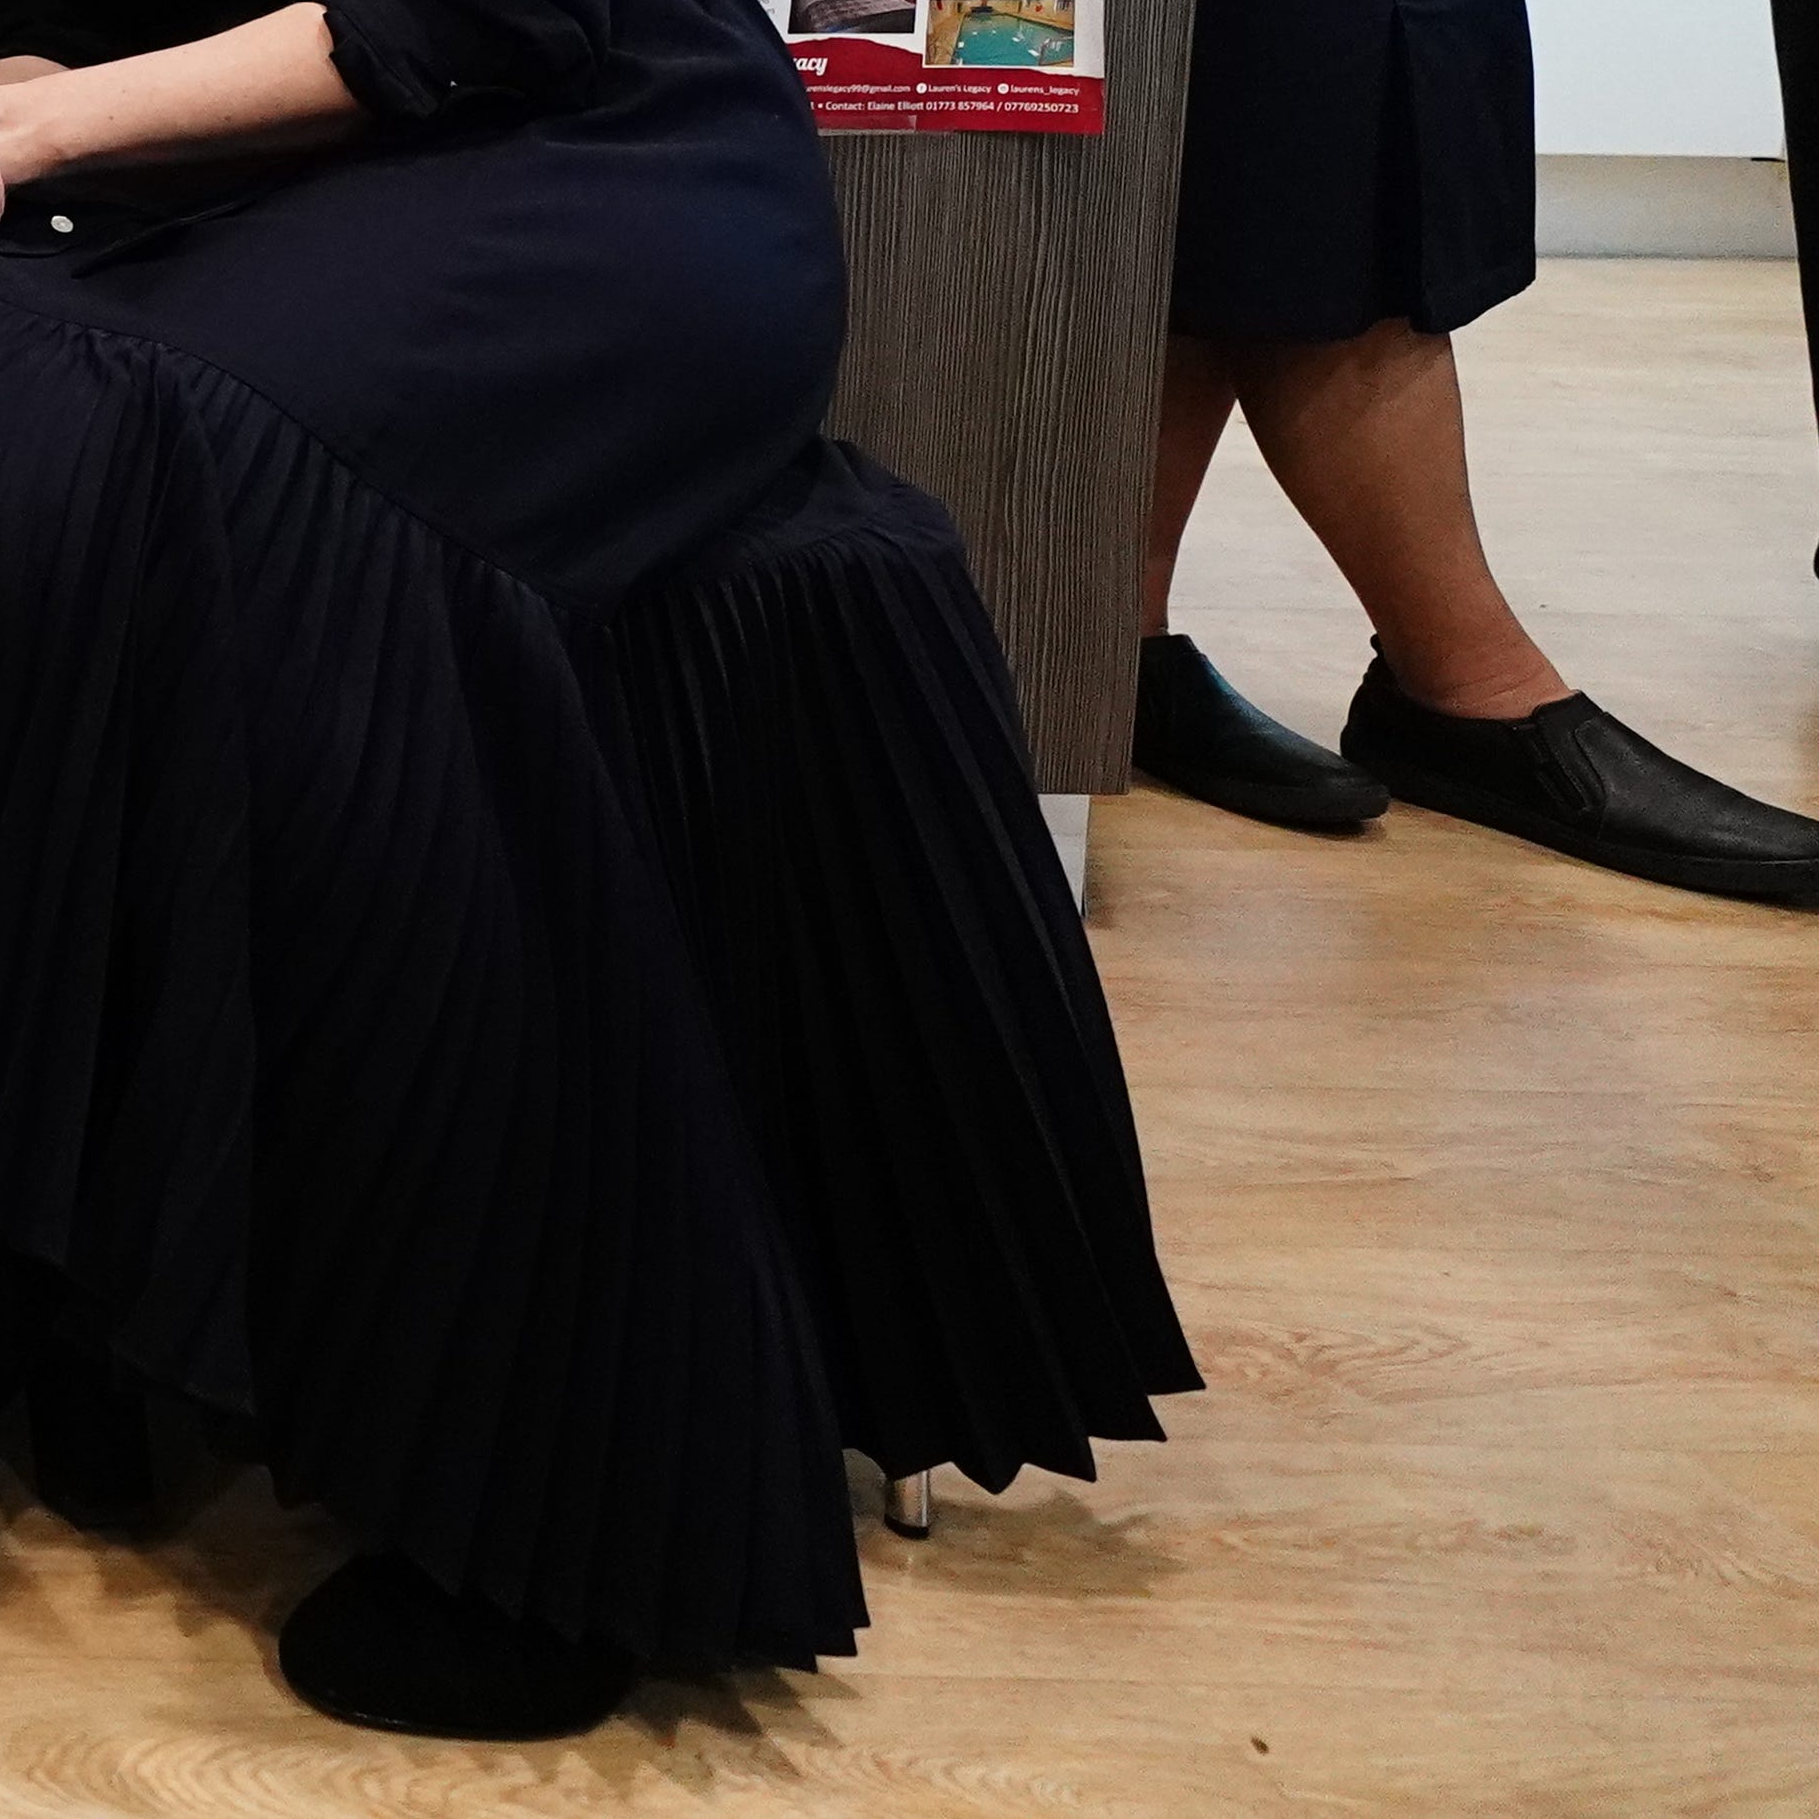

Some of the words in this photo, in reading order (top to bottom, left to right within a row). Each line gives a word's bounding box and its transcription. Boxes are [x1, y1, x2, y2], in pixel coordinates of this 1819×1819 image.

[867, 101, 894, 112] Elaine
[926, 101, 956, 112] 01773
[957, 101, 995, 112] 857964
[1004, 101, 1080, 114] 07769250723
